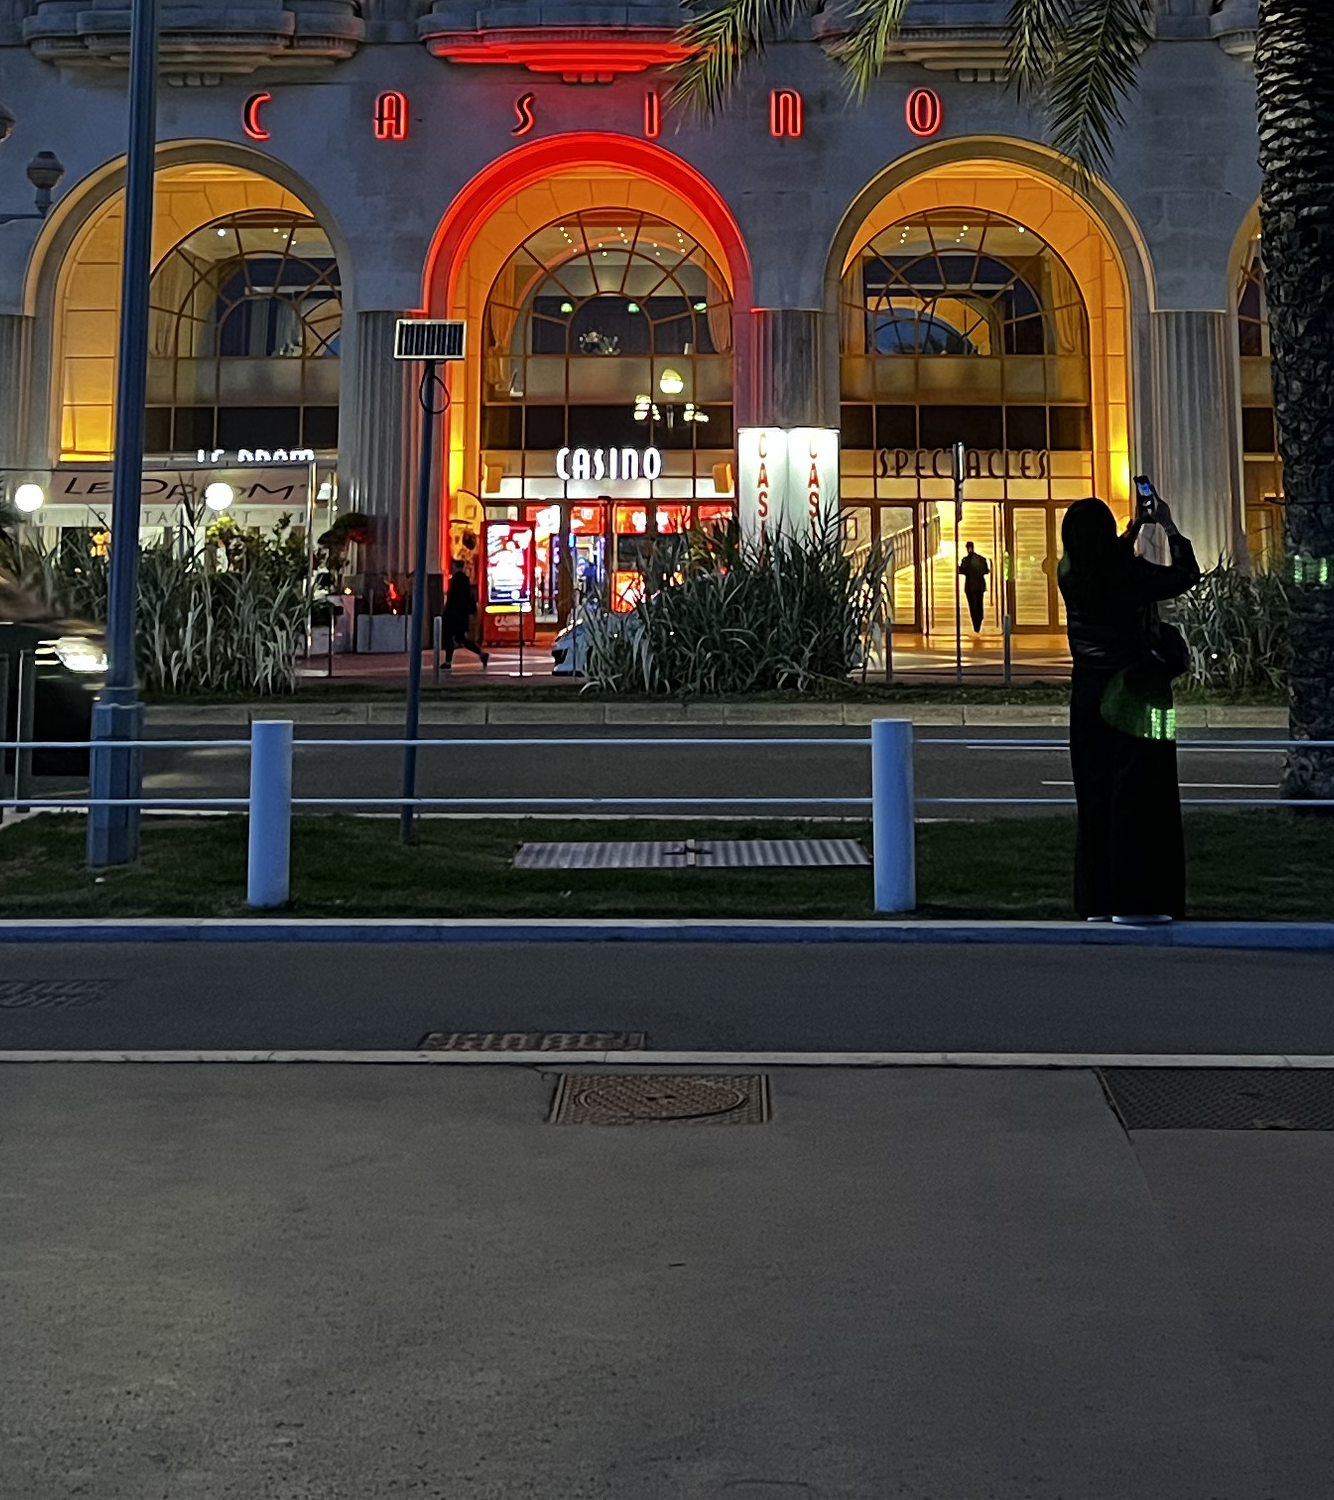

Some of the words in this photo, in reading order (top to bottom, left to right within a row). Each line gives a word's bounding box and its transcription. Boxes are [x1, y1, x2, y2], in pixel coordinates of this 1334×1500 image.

[241, 88, 942, 140] CASINO
[556, 446, 662, 481] CASINO
[879, 448, 1049, 480] SPECACLES
